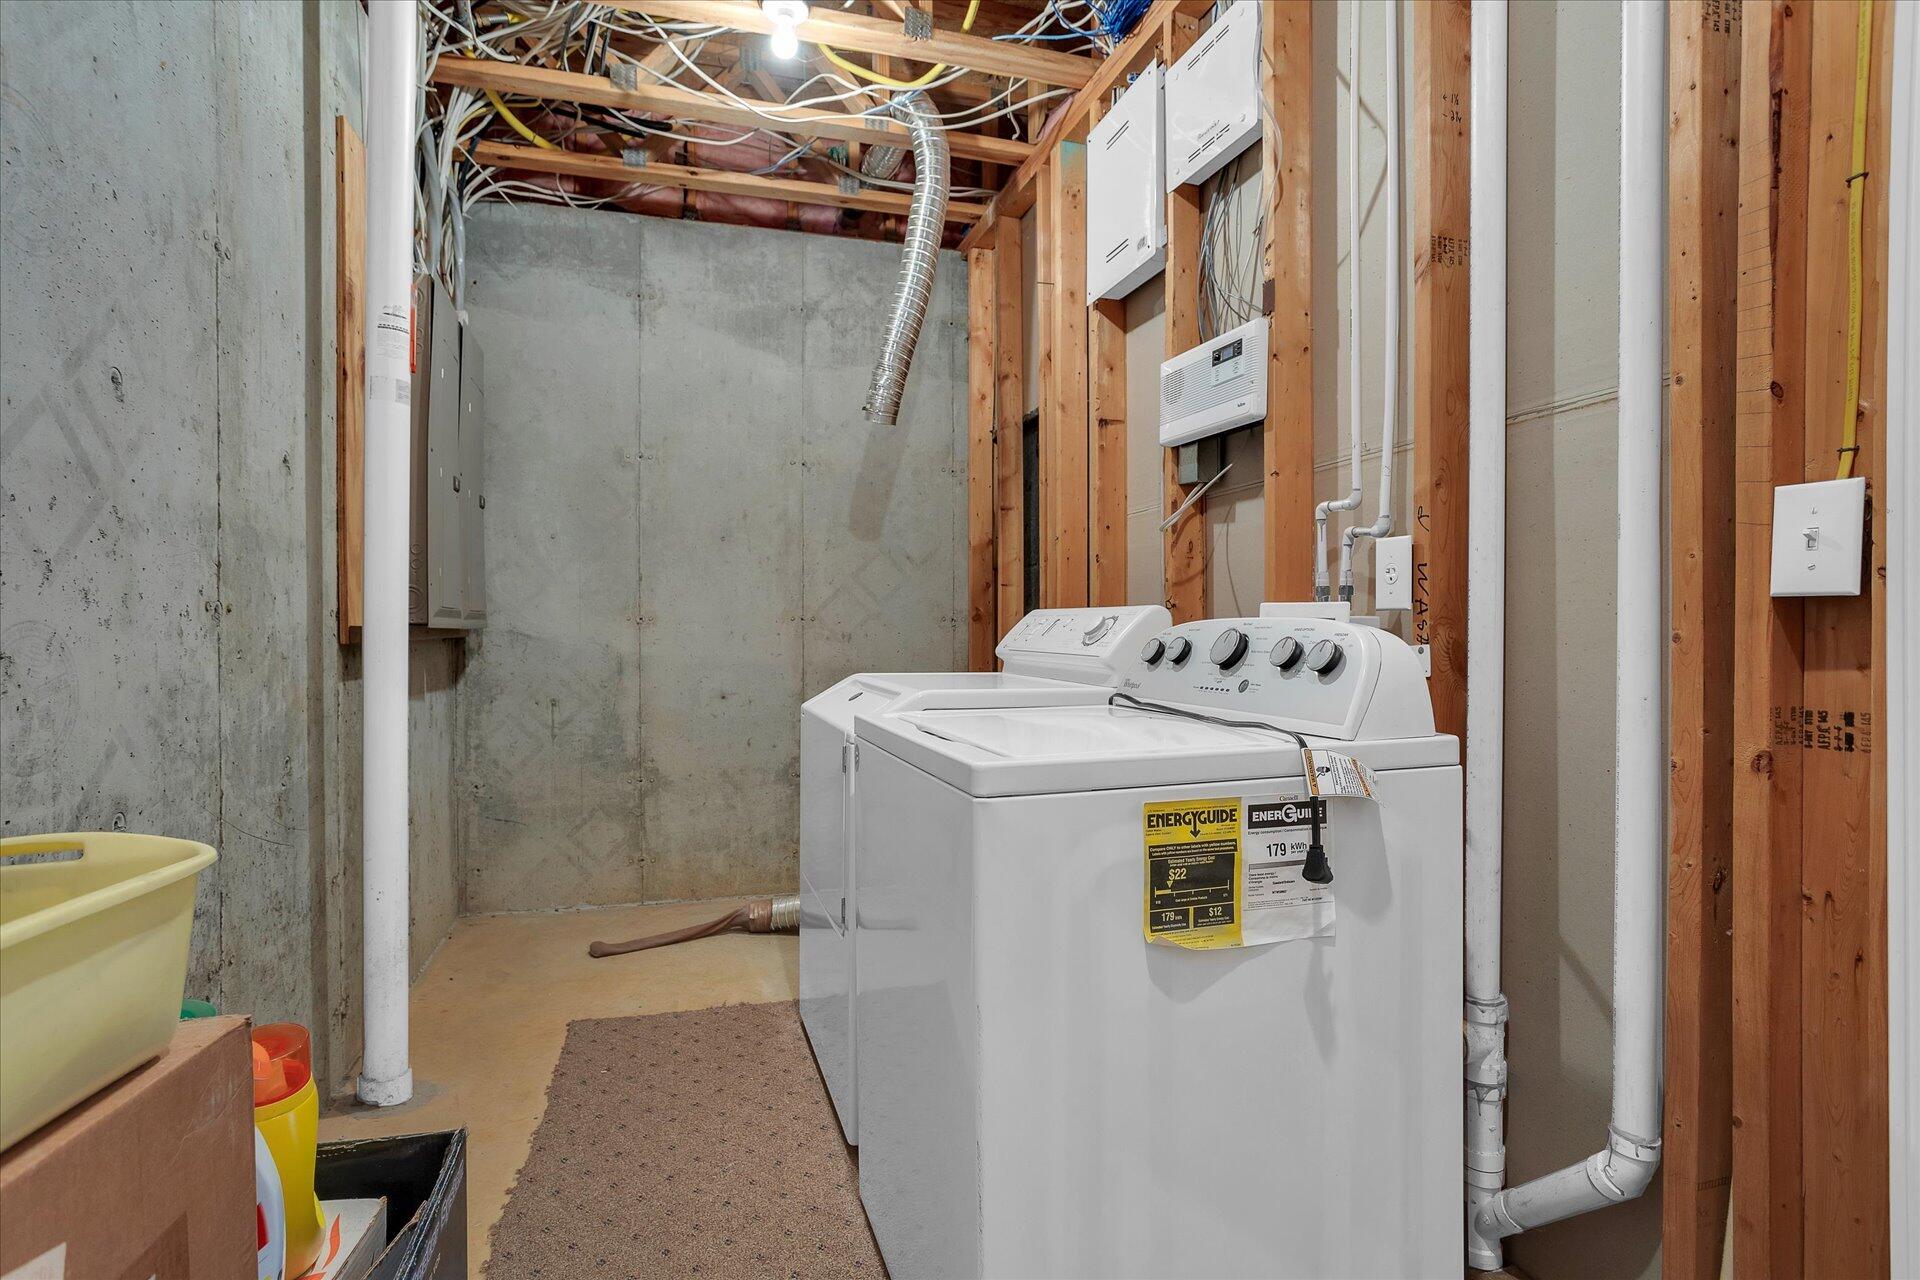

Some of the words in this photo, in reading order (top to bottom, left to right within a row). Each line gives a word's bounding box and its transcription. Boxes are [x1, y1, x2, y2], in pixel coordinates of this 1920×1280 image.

[1147, 808, 1237, 828] ENERGYGUIDE
[1266, 842, 1286, 858] 179
[1290, 842, 1307, 850] kWh
[1168, 868, 1186, 880] $22
[1162, 912, 1174, 922] 179
[1209, 906, 1222, 917] $12
